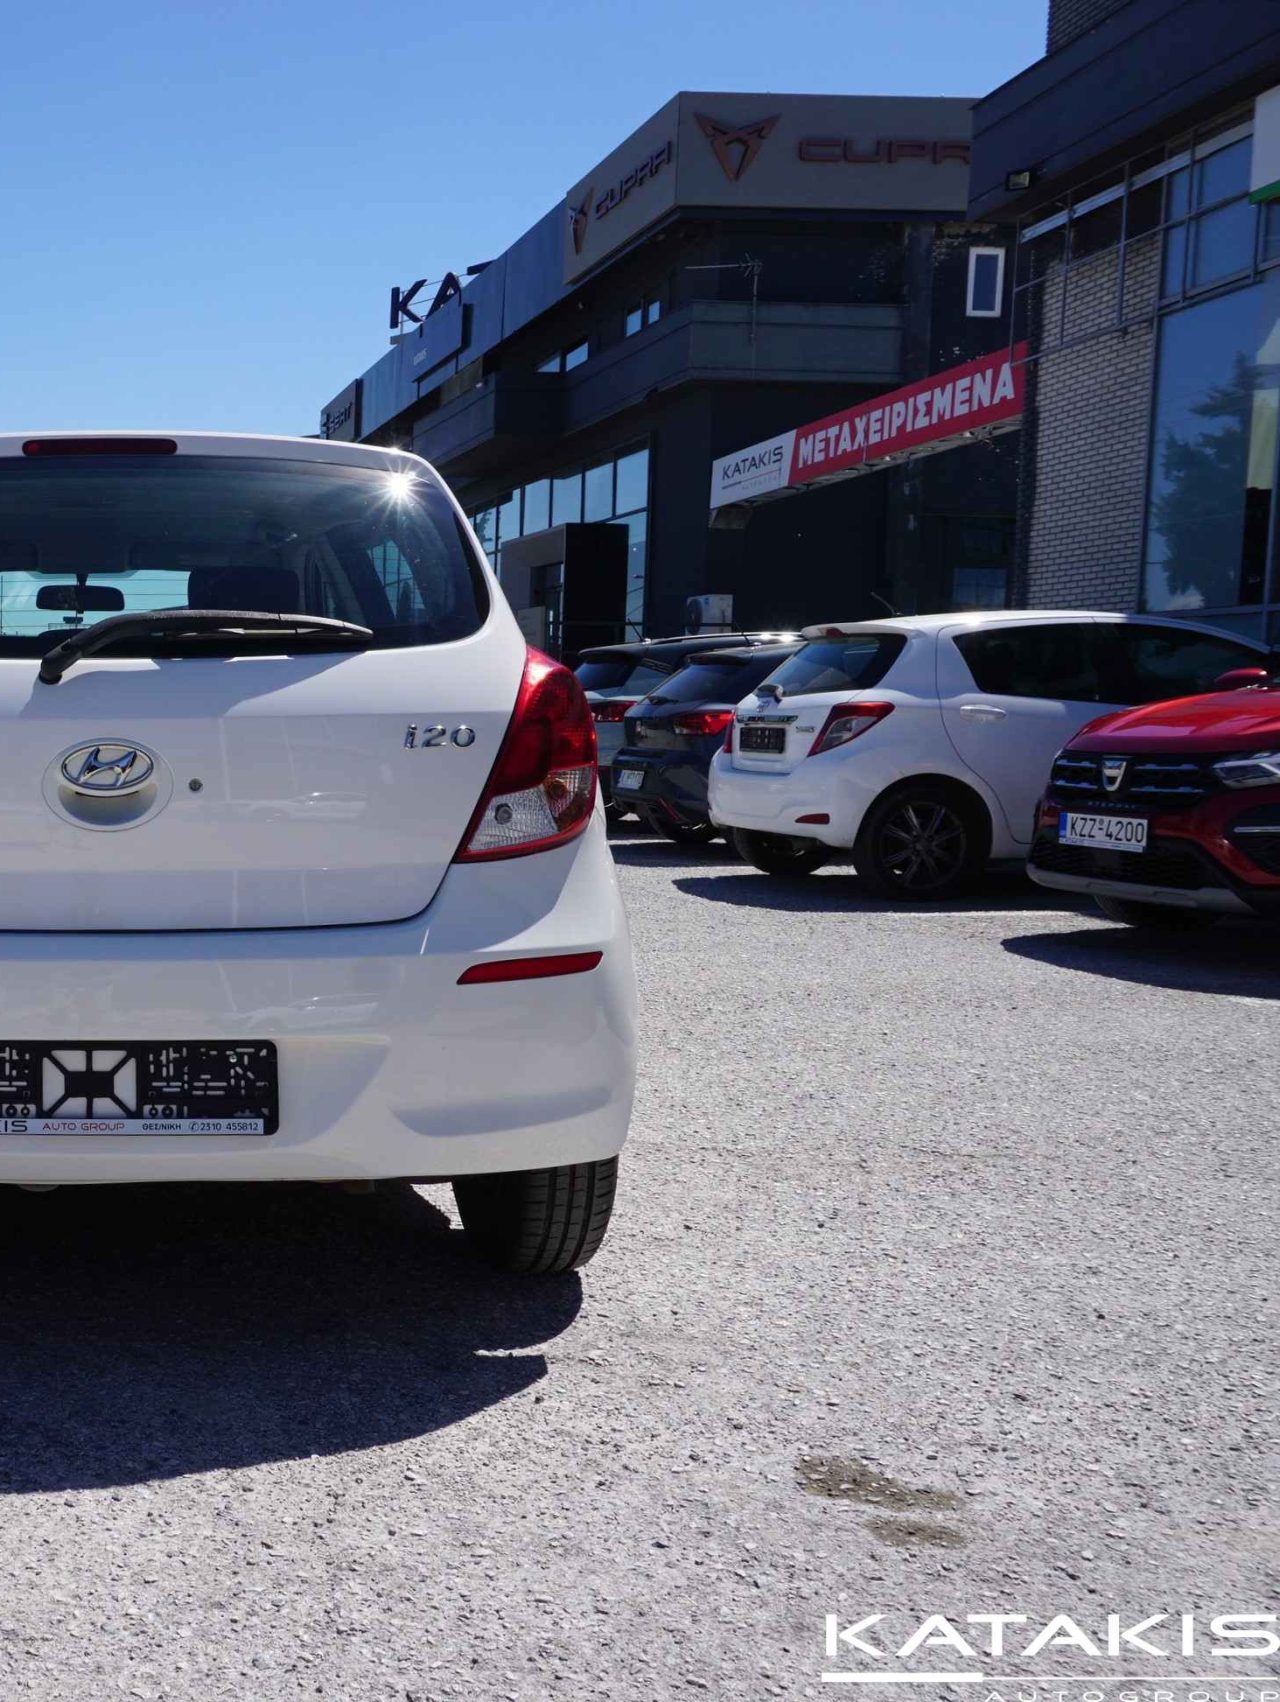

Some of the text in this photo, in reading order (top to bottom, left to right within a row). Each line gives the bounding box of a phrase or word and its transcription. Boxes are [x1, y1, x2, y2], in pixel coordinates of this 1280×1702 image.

[798, 361, 1015, 468] ΜΕΤΑΧΕΙΡΙΣΜΕΝΑ
[722, 445, 784, 481] KATAKIS
[404, 724, 476, 749] i20
[1070, 816, 1145, 843] KZZ-4200
[43, 1122, 77, 1131] AUTO
[81, 1122, 125, 1131] GROUP
[226, 1122, 258, 1131] 455812
